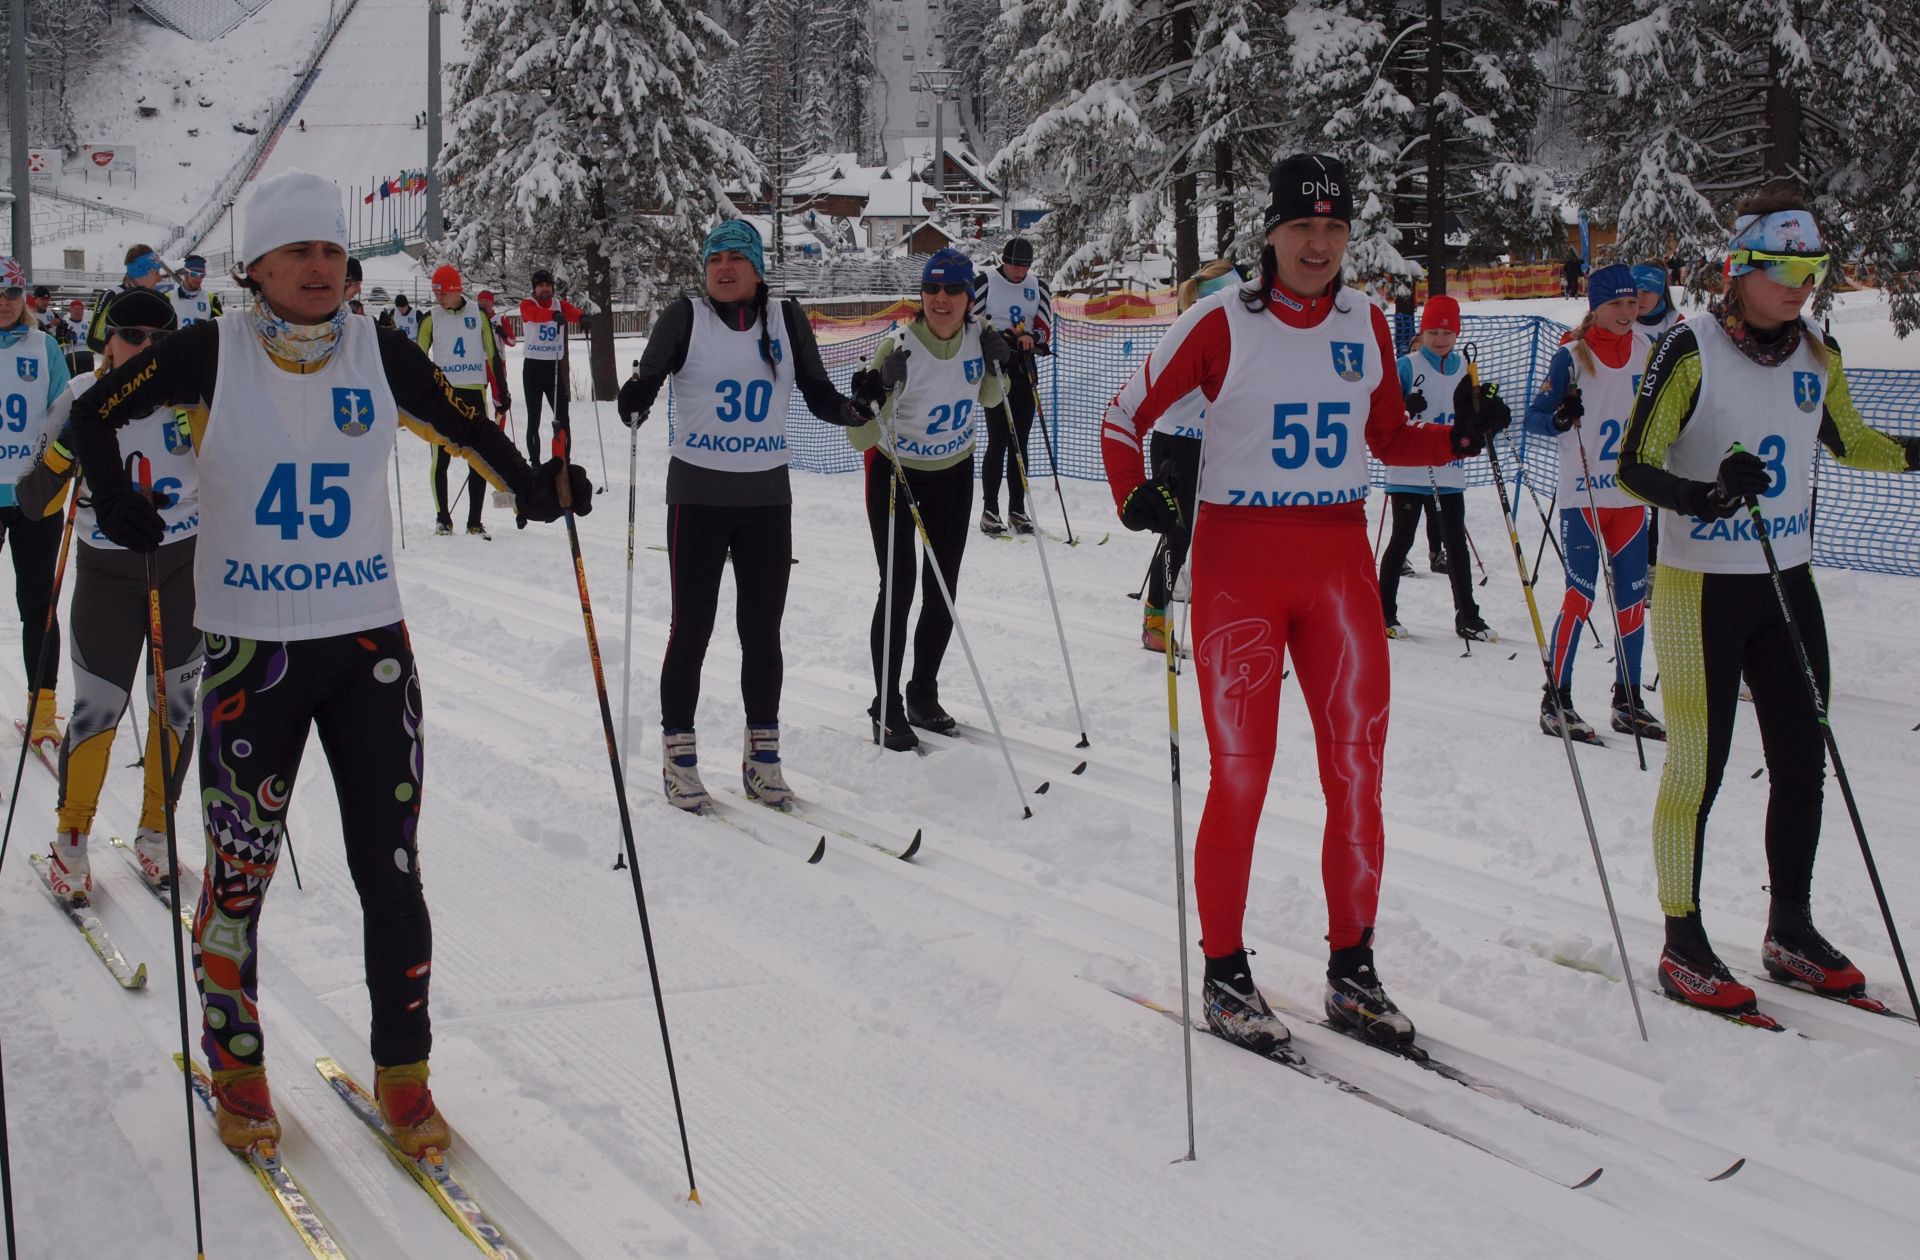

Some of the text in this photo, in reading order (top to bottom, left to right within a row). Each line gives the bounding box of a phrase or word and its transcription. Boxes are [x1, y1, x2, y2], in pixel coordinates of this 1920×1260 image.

[1301, 174, 1341, 200] DNB
[1009, 305, 1022, 324] 8
[452, 337, 465, 357] 4
[539, 325, 557, 341] 59
[715, 379, 773, 422] 30
[1641, 372, 1657, 397] LKS
[0, 393, 27, 432] 9
[926, 399, 973, 435] 20
[1271, 402, 1351, 470] 55
[1599, 418, 1629, 461] 2
[1758, 434, 1787, 498] 3
[255, 463, 351, 540] 45
[223, 554, 388, 591] ZAKOPANE
[1671, 970, 1716, 995] ATOMIC
